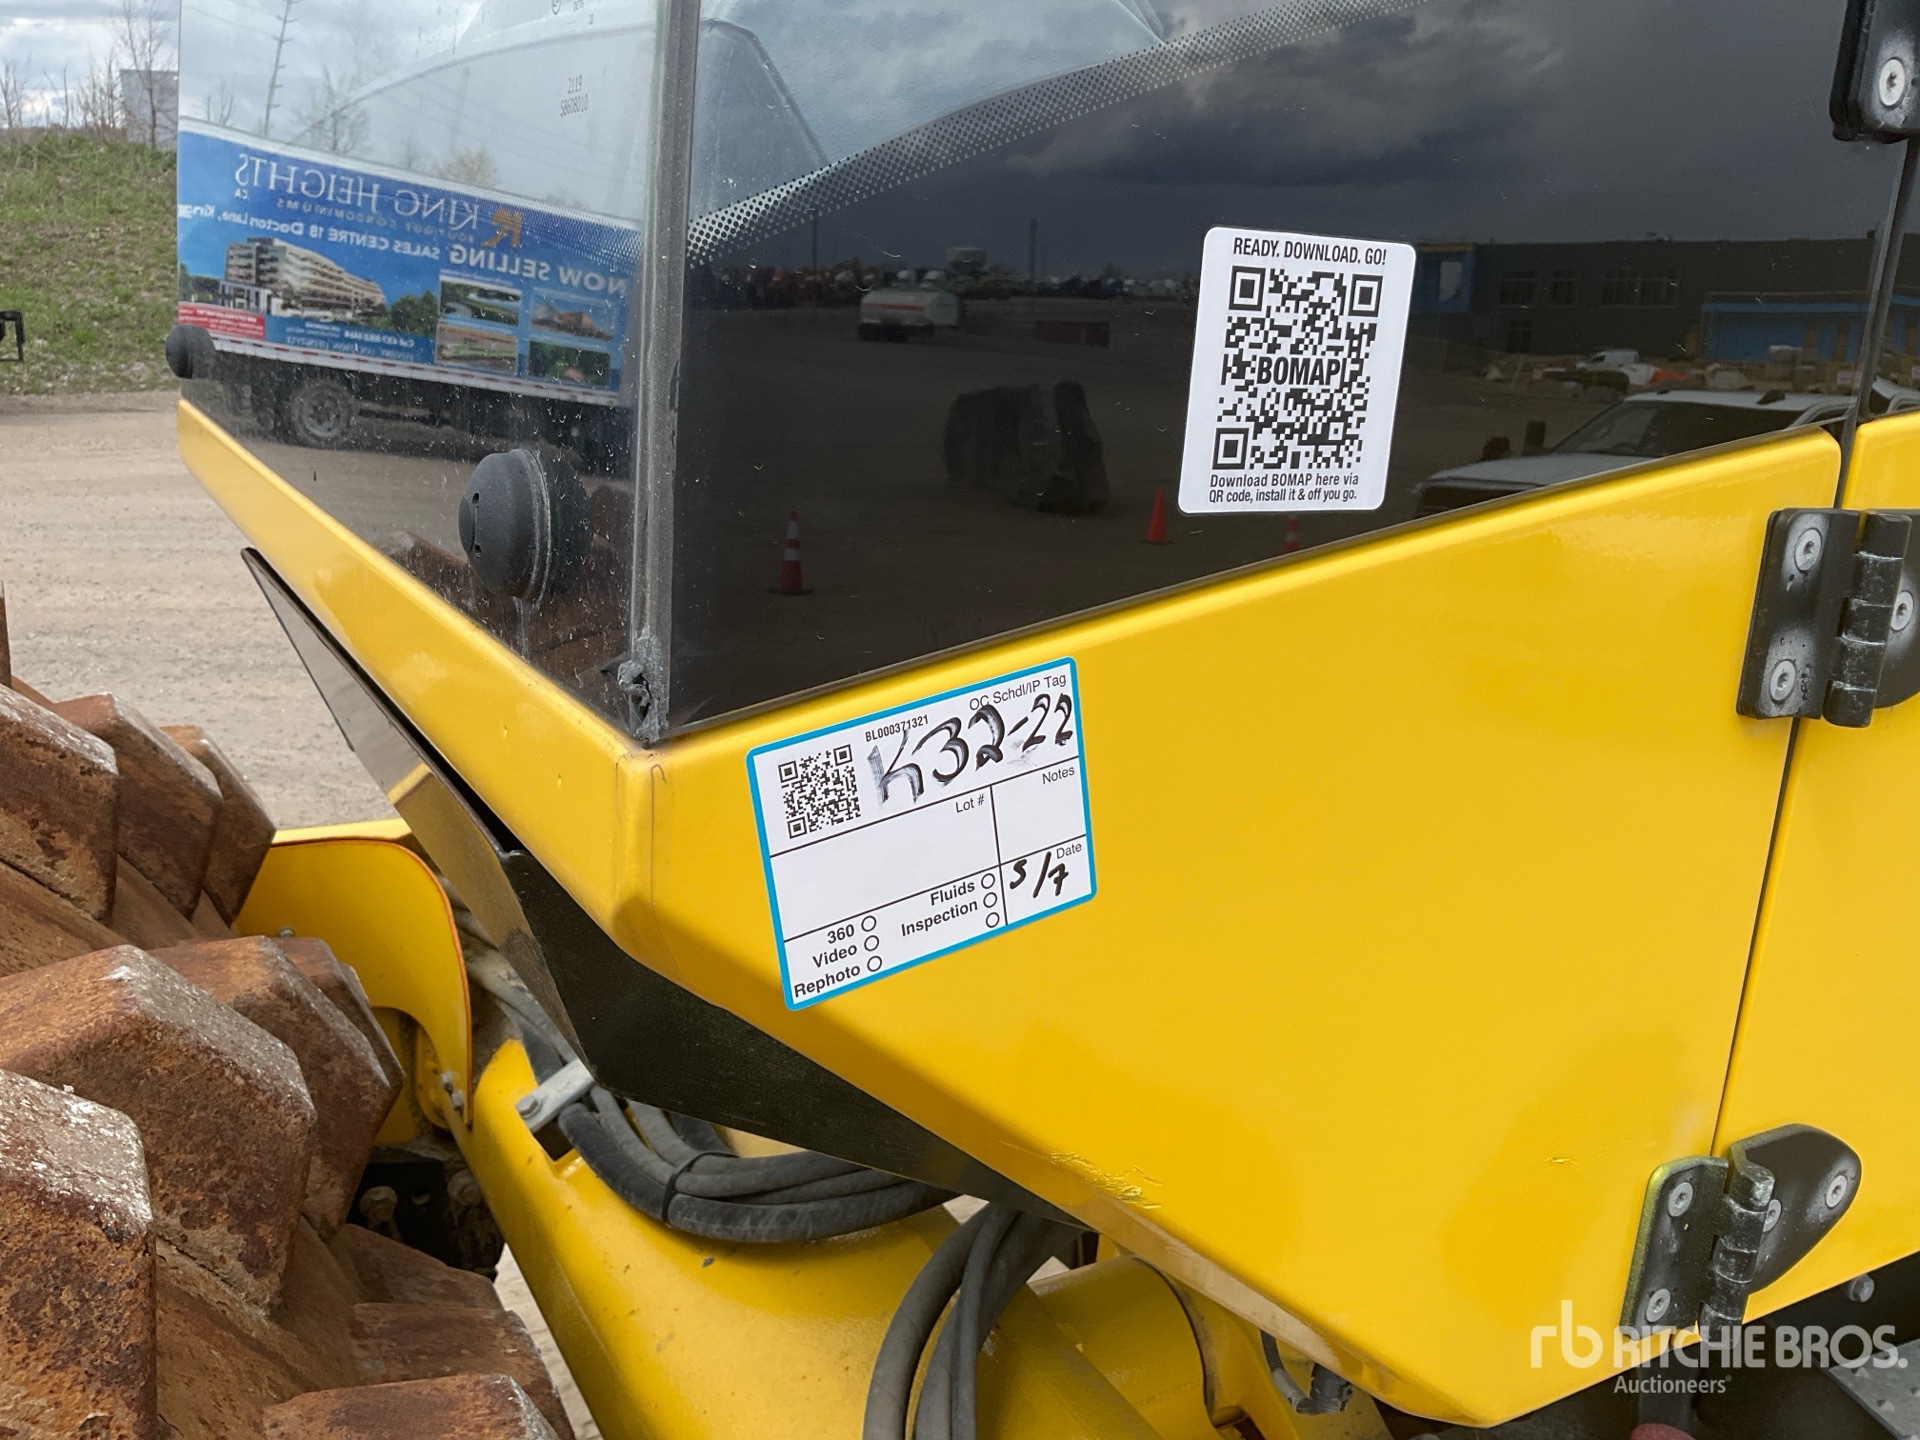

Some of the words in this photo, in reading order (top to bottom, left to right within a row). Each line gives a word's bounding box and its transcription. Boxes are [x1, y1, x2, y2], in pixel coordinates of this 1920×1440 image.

[1233, 236, 1280, 258] READY.
[1283, 240, 1361, 264] DOWNLOAD.
[1364, 247, 1387, 266] GO!
[1257, 356, 1341, 386] BOMAP
[1210, 473, 1268, 488] Download
[1271, 473, 1312, 487] BOMAP
[1315, 472, 1340, 486] here
[1343, 472, 1359, 486] via
[1209, 489, 1224, 503] QR
[1226, 488, 1254, 504] code,
[1255, 488, 1287, 502] install
[1288, 487, 1296, 501] it
[1297, 488, 1306, 501] &
[1308, 487, 1322, 501] off
[1323, 490, 1341, 505] you
[1342, 489, 1357, 504] go.
[992, 679, 1041, 704] Schdl/IP
[1043, 674, 1067, 689] Tag
[865, 714, 929, 743] BL000371321
[867, 693, 1074, 806] K32-22
[1042, 766, 1075, 785] Notes
[955, 796, 975, 813] Lot
[976, 793, 985, 807] #
[1056, 842, 1083, 860] Date
[930, 880, 976, 906] Fluids
[901, 899, 979, 937] Inspection
[827, 925, 855, 945] 360
[812, 944, 858, 969] Video
[793, 965, 861, 998] Rephoto
